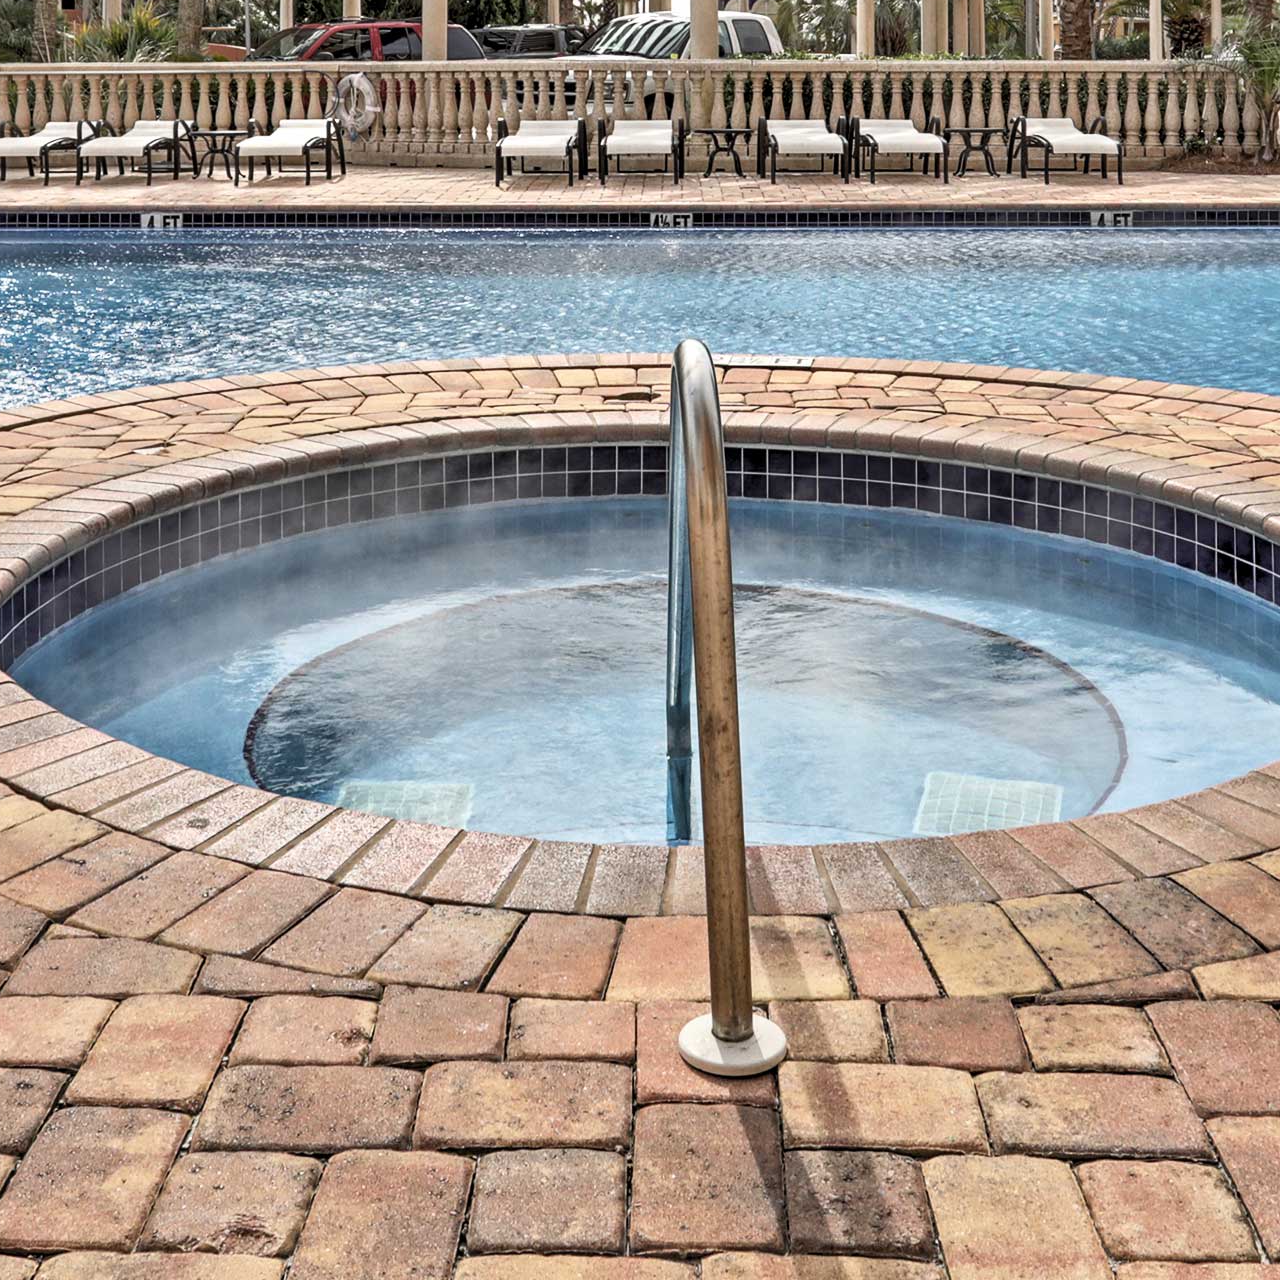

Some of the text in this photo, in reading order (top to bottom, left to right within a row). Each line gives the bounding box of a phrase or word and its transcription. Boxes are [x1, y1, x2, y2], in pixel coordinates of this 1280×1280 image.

[163, 215, 180, 229] FT
[673, 215, 691, 228] FT
[1113, 213, 1131, 227] FT
